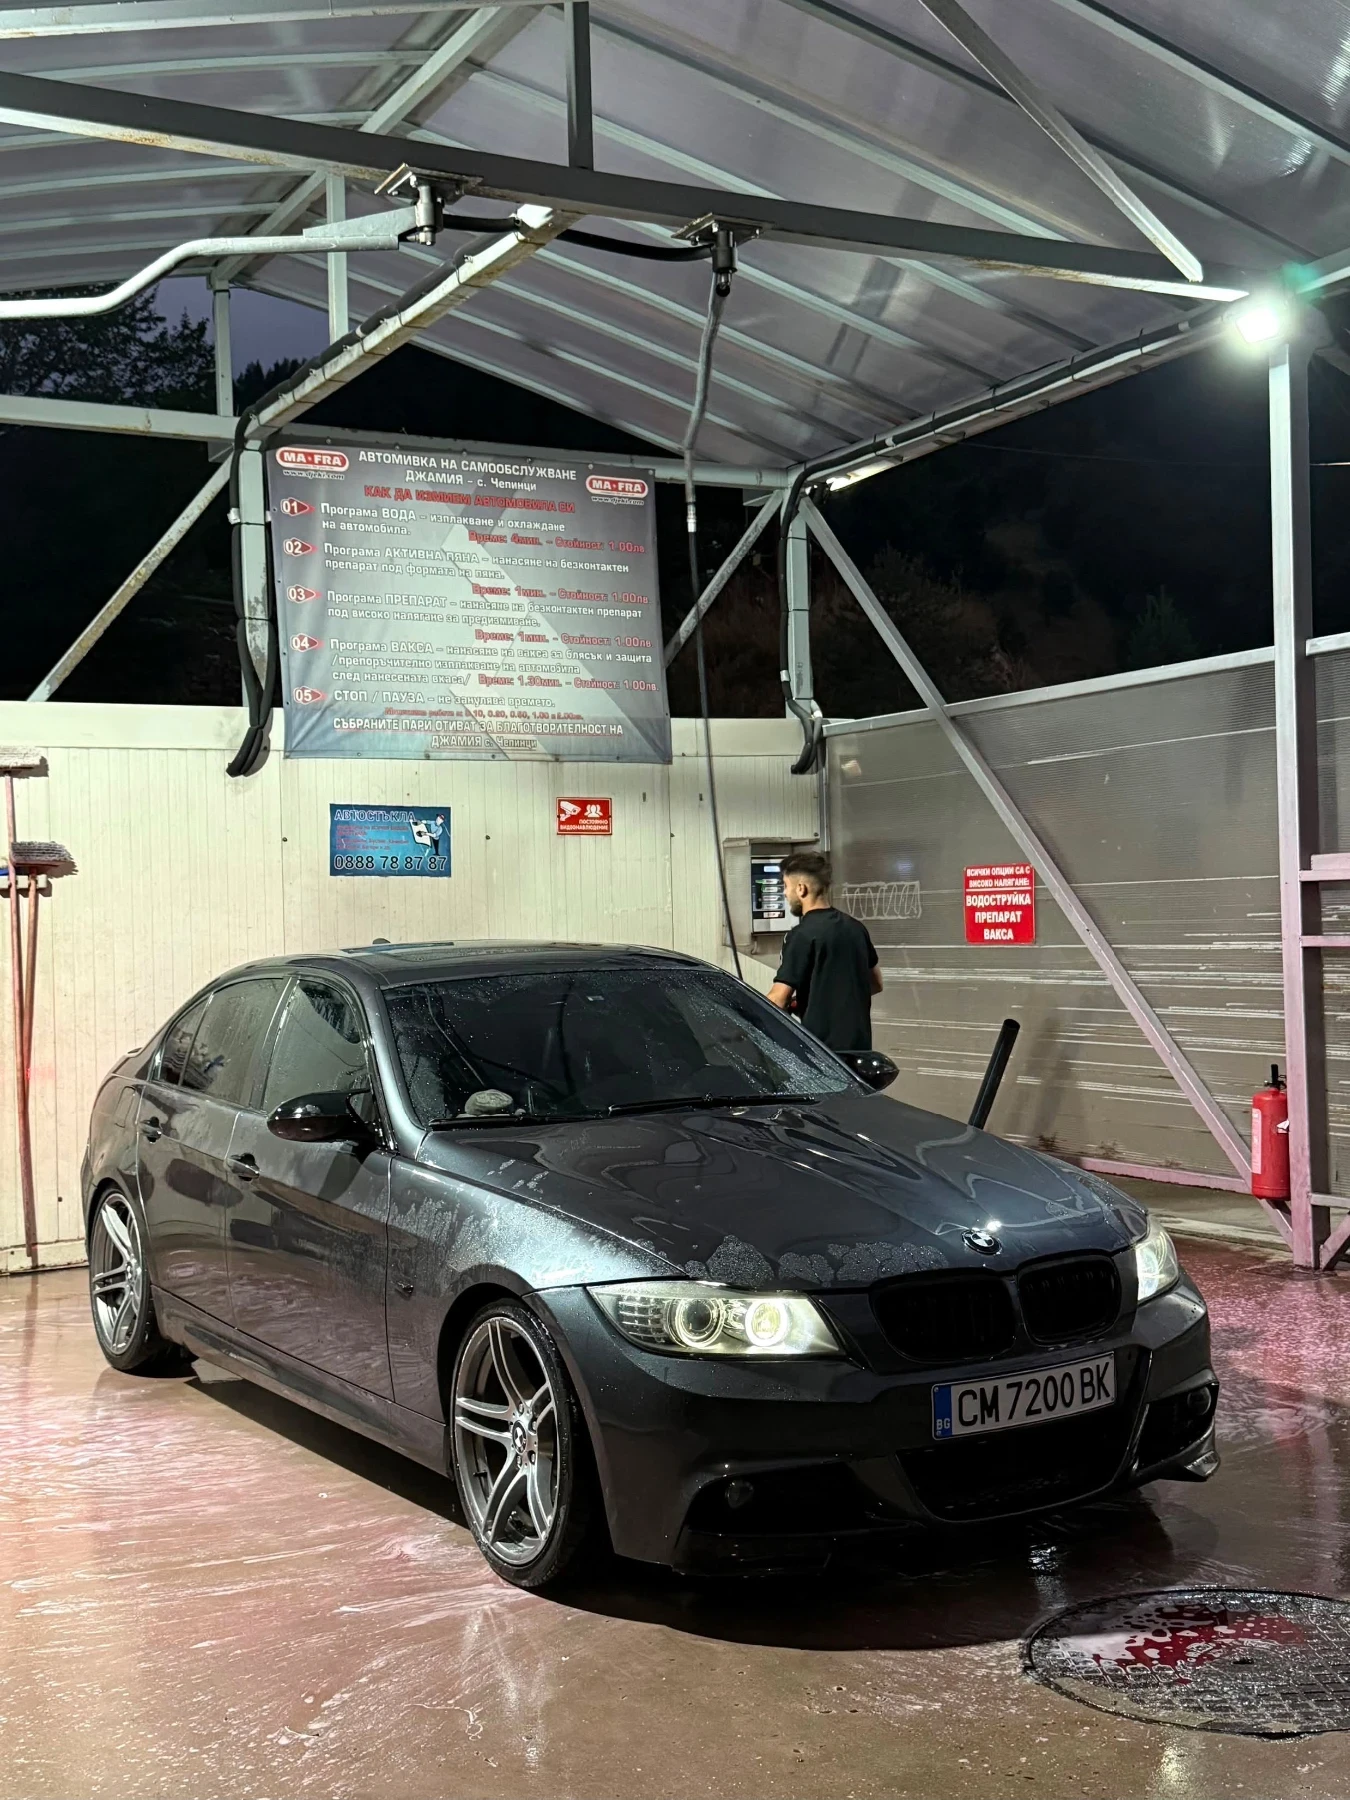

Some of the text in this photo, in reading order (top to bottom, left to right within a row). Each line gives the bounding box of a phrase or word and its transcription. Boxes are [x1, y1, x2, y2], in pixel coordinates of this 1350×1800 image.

[359, 451, 576, 481] АВТОМИВКА НА САМООБСЛУЖВАНЕ
[405, 470, 463, 485] ДЖАМИЯ
[477, 479, 486, 487] с.
[491, 477, 537, 491] Чепинци
[282, 501, 298, 513] 01
[364, 485, 391, 499] КАК
[394, 488, 412, 501] ДА
[475, 494, 557, 512] АВТОМОБИЛА
[559, 501, 575, 513] СИ
[321, 503, 378, 520] Програма
[382, 508, 416, 521] ВОДА
[431, 514, 494, 526] изплакване
[508, 521, 565, 532] охлаждане
[322, 521, 411, 535] на автомобила.
[285, 541, 302, 553] 02
[468, 530, 507, 544] Време:
[555, 537, 604, 550] Стойност:
[324, 543, 380, 560] Програма
[385, 548, 442, 560] АКТИВНА
[446, 551, 479, 563] ПЯНА
[492, 557, 542, 567] нанасяне
[560, 559, 629, 573] безконтактен
[325, 560, 505, 579] препарат под формата на пяна.
[289, 588, 305, 600] 03
[472, 583, 511, 598] Време:
[515, 586, 546, 597] 1мин.
[558, 588, 608, 601] Стойност:
[327, 591, 381, 607] Програма
[385, 594, 447, 608] ПРЕПАРАТ
[460, 600, 509, 611] нанасяне
[512, 603, 525, 611] на
[528, 601, 595, 614] безконтактен
[597, 608, 642, 618] препарат
[328, 608, 348, 619] под
[352, 609, 390, 619] високо
[393, 612, 444, 624] налягане
[292, 637, 309, 649] 04
[475, 629, 514, 643] Време:
[518, 631, 549, 643] 1мин.
[561, 633, 611, 646] Стойност:
[330, 639, 387, 656] Програма
[391, 641, 434, 653] ВАКСА
[447, 646, 498, 656] нанасяне
[501, 649, 514, 657] на
[517, 650, 548, 658] вакса
[566, 649, 602, 660] блясък
[615, 654, 652, 663] защита
[332, 655, 580, 674] /препоръчително изплакване на автомобила
[333, 672, 360, 682] след
[364, 673, 429, 683] нанесената
[478, 674, 514, 687] Време:
[574, 677, 620, 689] Стойност:
[624, 680, 659, 691] 1.00лв.
[295, 690, 312, 702] 05
[334, 690, 368, 702] СТОП
[383, 692, 424, 703] ПАУЗА
[438, 696, 451, 704] не
[454, 697, 505, 706] занулява
[508, 698, 555, 708] времето.
[334, 718, 623, 735] СЪБРАНИТЕ ПАРИ ОТИВАТ ЗА БЛАГОТВОРИТЕЛНОСТ НА
[432, 735, 482, 748] ДЖАМИЯ
[496, 736, 537, 749] Чепинци
[334, 810, 415, 822] АВТОСТЪКЛА
[334, 855, 447, 871] 0888 78 87 87
[967, 868, 990, 876] ВСИЧКИ
[992, 867, 1014, 876] ОПЦИИ
[969, 878, 1029, 887] ВИСОКО НАЛЯГАНЕ:
[966, 892, 1031, 908] ВОДОСТРУЙКА
[975, 911, 1022, 923] ПРЕПАРАТ
[984, 929, 1013, 939] ВАКСА
[958, 1362, 1110, 1426] CM 7200 BK
[936, 1418, 950, 1430] BG
